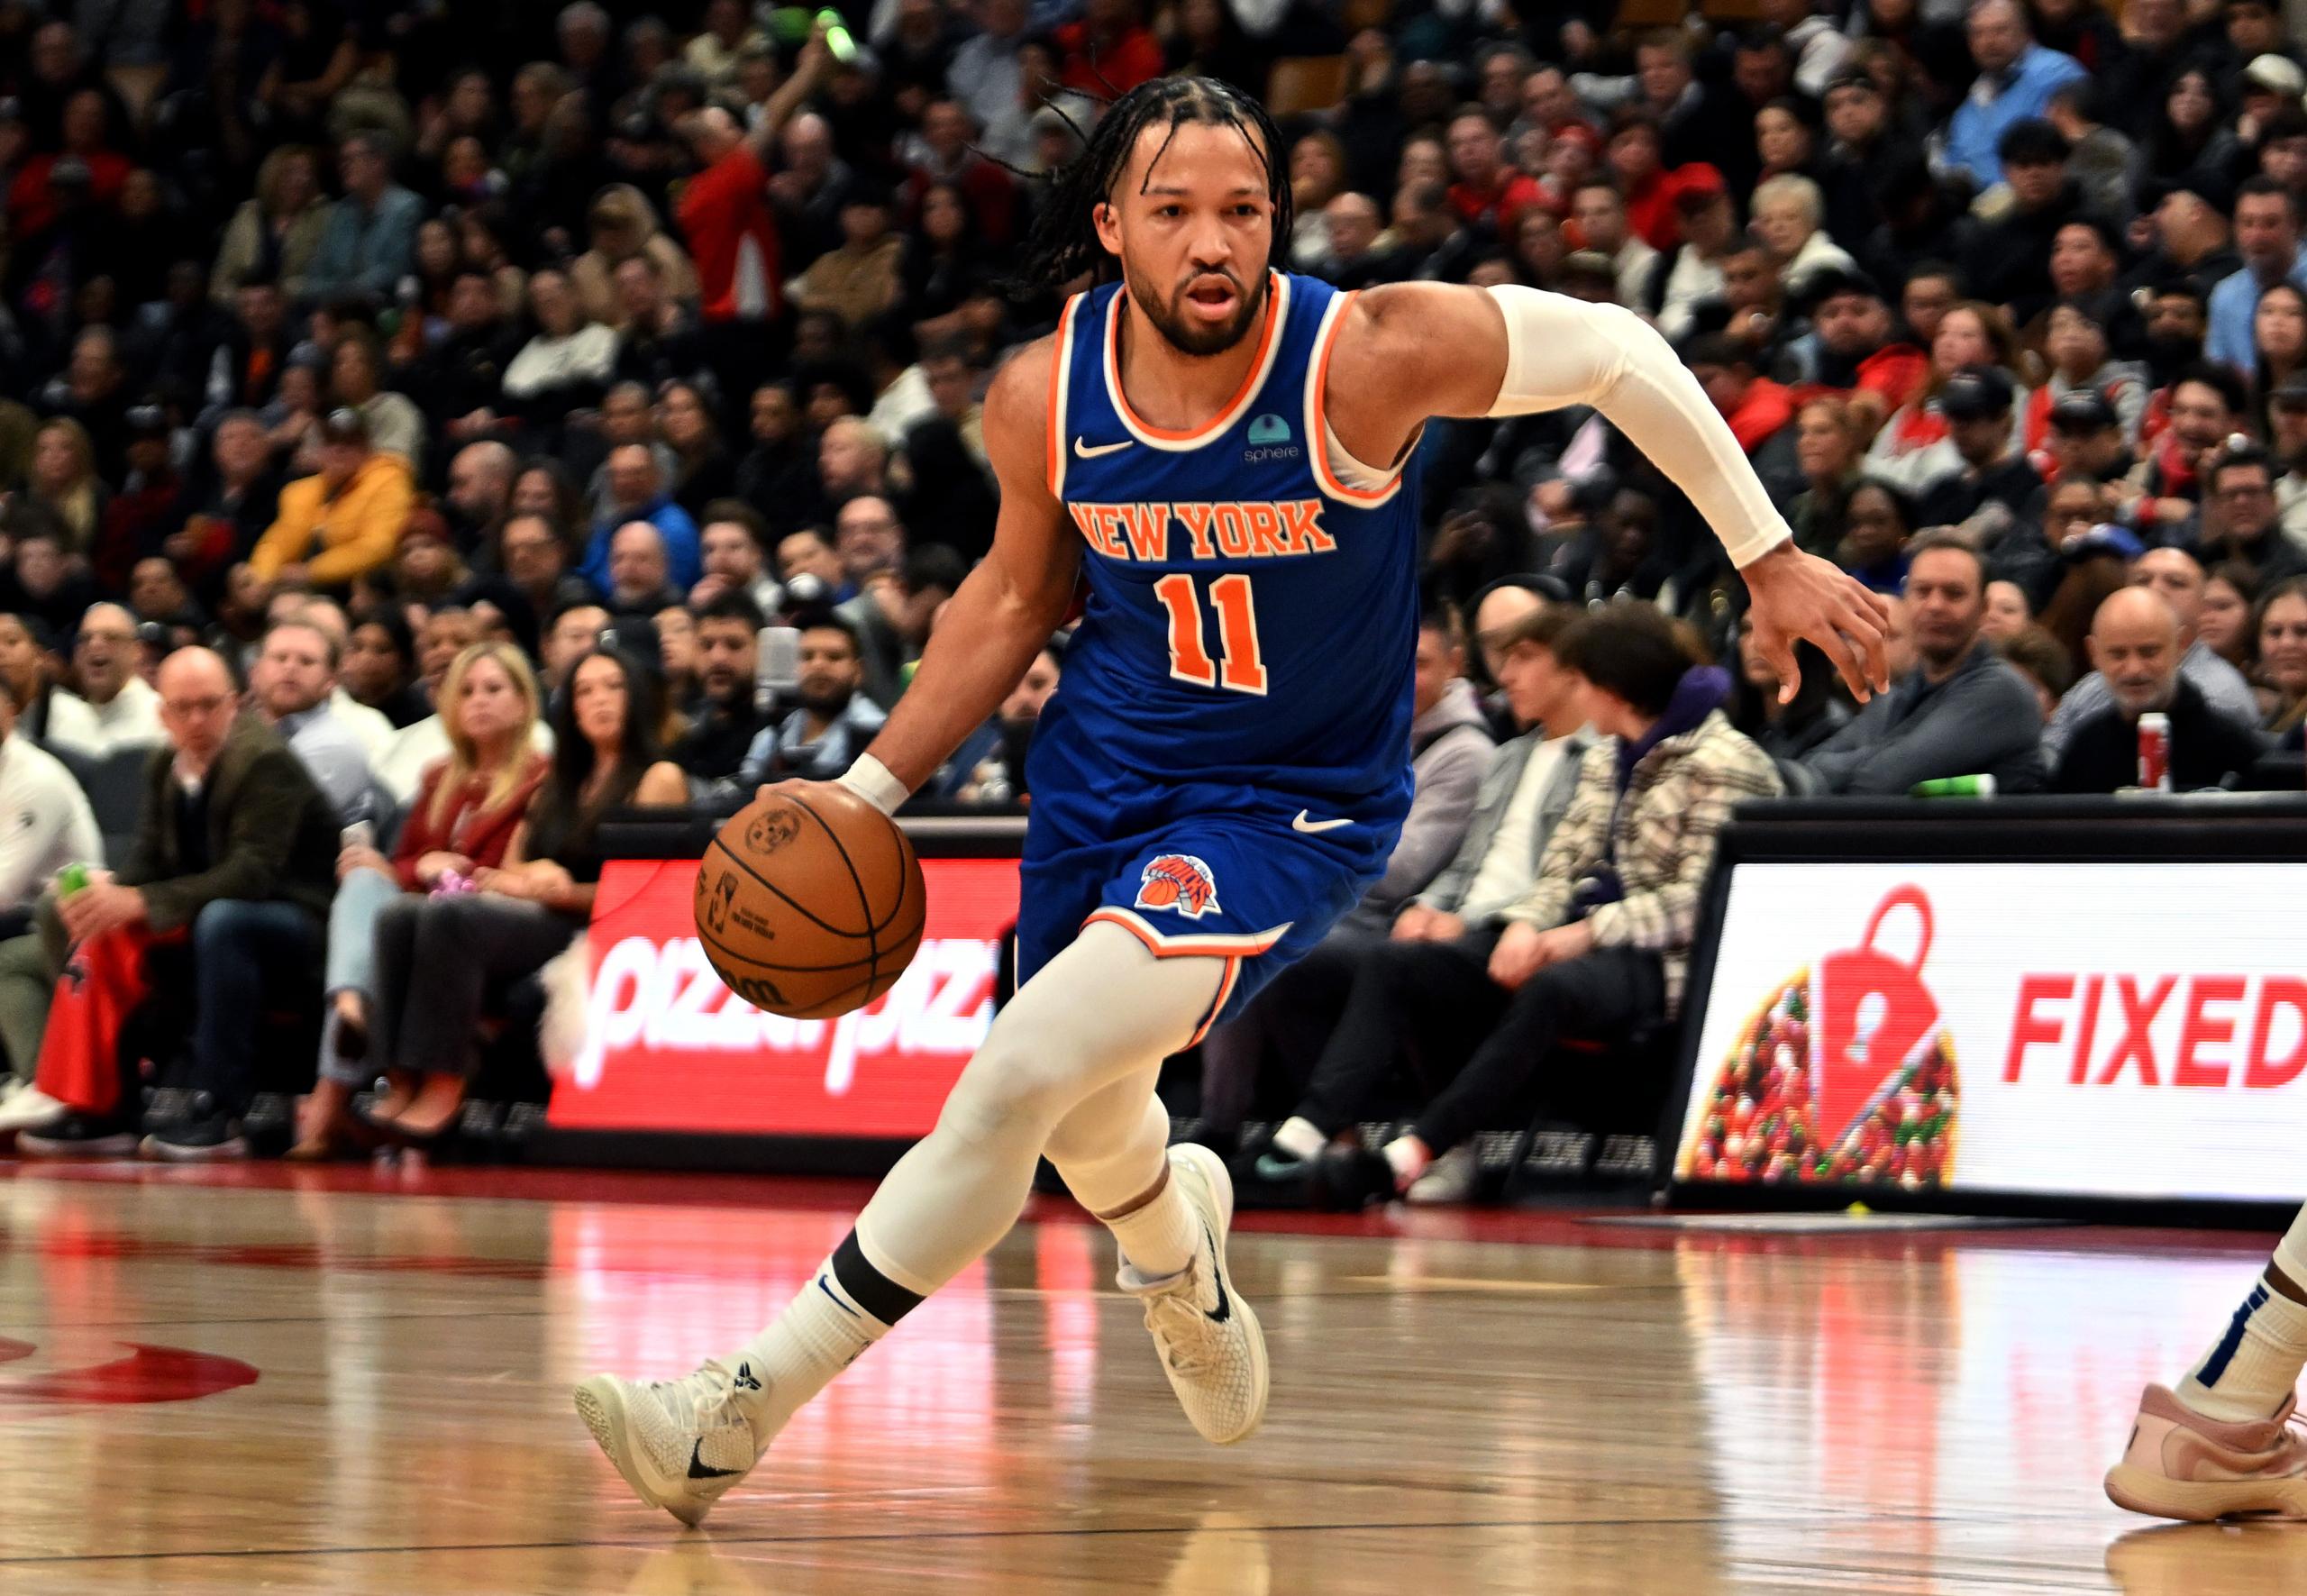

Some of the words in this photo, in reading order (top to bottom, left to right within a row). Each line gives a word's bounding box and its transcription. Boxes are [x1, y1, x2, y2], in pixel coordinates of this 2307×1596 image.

[1244, 446, 1299, 463] sphere
[1067, 501, 1172, 561] NEW
[1173, 498, 1338, 561] YORK
[1153, 573, 1268, 696] 11
[574, 935, 823, 1090] piz
[824, 938, 1000, 1097] piz
[2002, 971, 2307, 1089] FIXED
